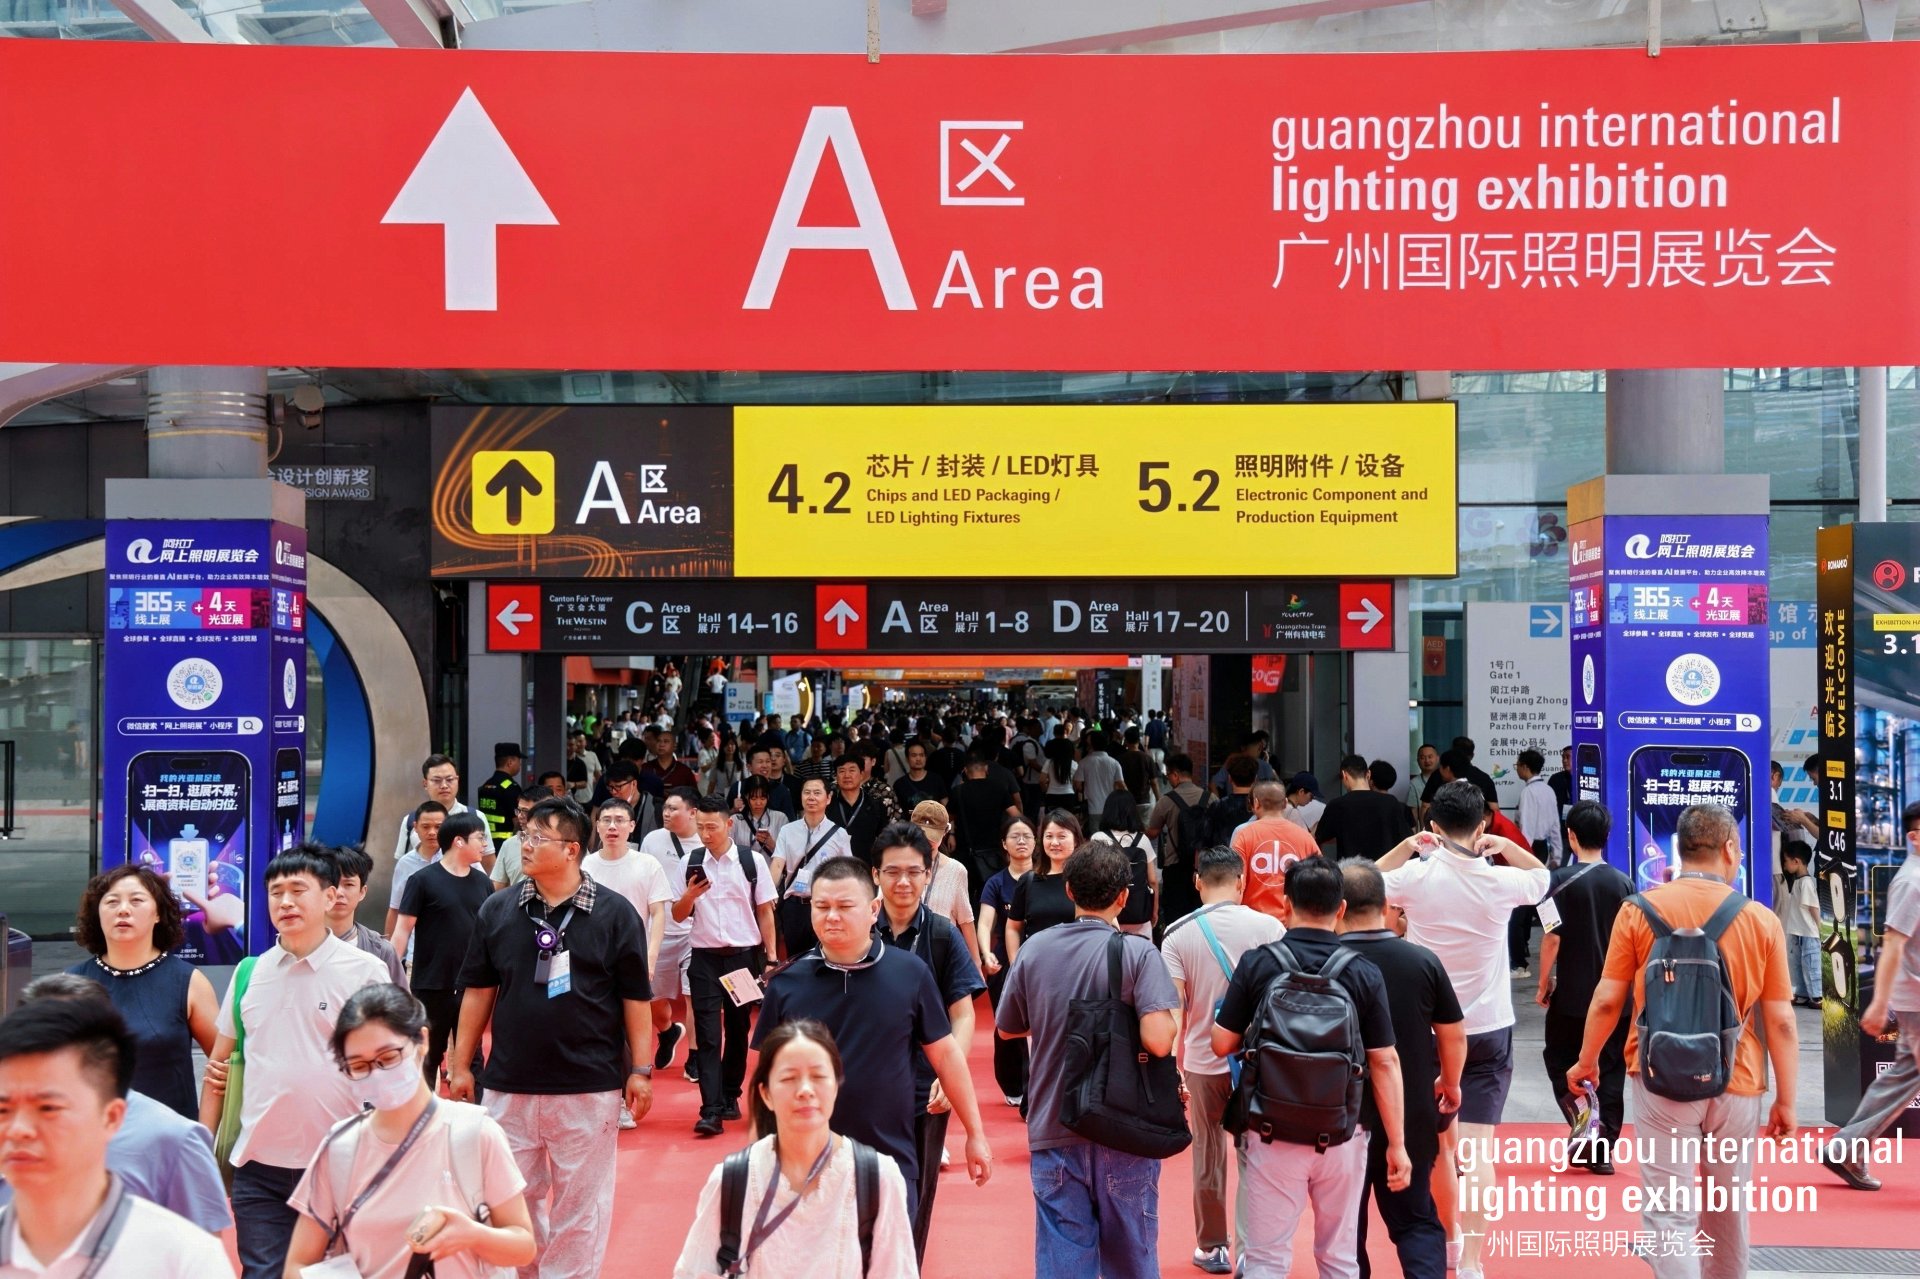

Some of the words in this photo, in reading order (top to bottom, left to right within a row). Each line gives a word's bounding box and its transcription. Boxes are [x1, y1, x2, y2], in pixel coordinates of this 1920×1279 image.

[1272, 103, 1520, 161] guangzhou
[1541, 97, 1840, 147] international
[940, 121, 1024, 206] 区
[1273, 165, 1457, 222] lighting
[1478, 162, 1727, 210] exhibition
[742, 106, 917, 310] A
[1273, 227, 1836, 290] 广州国际照明展览会
[933, 250, 1103, 309] Area
[867, 454, 914, 478] 芯片
[937, 454, 985, 478] 封装
[1008, 454, 1099, 477] LED灯具
[1235, 454, 1333, 478] 照明附件
[1355, 454, 1404, 477] 设备
[641, 465, 667, 493] 区
[331, 488, 370, 498] AWARD
[576, 461, 631, 524] A
[768, 464, 851, 513] 4.2
[1139, 462, 1220, 512] 5.2
[867, 489, 907, 504] Chips
[912, 489, 938, 501] and
[944, 489, 971, 501] LED
[977, 489, 1050, 504] Packaging
[1237, 488, 1307, 501] Electronic
[1313, 488, 1396, 503] Component
[1401, 488, 1427, 500] and
[638, 500, 700, 524] Area
[868, 511, 894, 523] LED
[901, 511, 958, 526] Lighting
[964, 511, 1020, 523] Fixtures
[1237, 511, 1314, 523] Production
[1321, 510, 1398, 525] Equipment
[159, 548, 260, 563] 网上照明展览会
[1655, 545, 1755, 558] 网上照明展览会
[660, 602, 691, 613] Area
[919, 601, 948, 612] Area
[1089, 601, 1118, 611] Area
[135, 614, 170, 625] 线上展
[209, 614, 243, 625] 光亚展
[573, 617, 607, 625] WESTIN
[626, 601, 653, 633] C
[698, 613, 721, 623] Hall
[881, 601, 912, 633] A
[956, 612, 978, 621] Hall
[1053, 600, 1081, 632] D
[1126, 611, 1149, 620] Hall
[1634, 609, 1668, 620] 线上展
[1706, 610, 1740, 620] 光亚展
[663, 615, 680, 634] 区
[698, 623, 721, 633] 展厅
[921, 615, 938, 633] 区
[955, 622, 978, 632] 展厅
[1091, 614, 1108, 632] 区
[1126, 622, 1148, 632] 展厅
[1792, 628, 1807, 640] of
[1490, 661, 1514, 670] 1号门
[1837, 609, 1846, 737] WELCOME
[1490, 671, 1514, 680] Gate
[1825, 610, 1835, 738] 欢迎光临
[1490, 696, 1534, 706] Yuejiang
[1536, 696, 1568, 706] Zhong
[1526, 723, 1551, 732] Ferry
[1829, 780, 1843, 801] 3.1
[1828, 831, 1846, 851] C46
